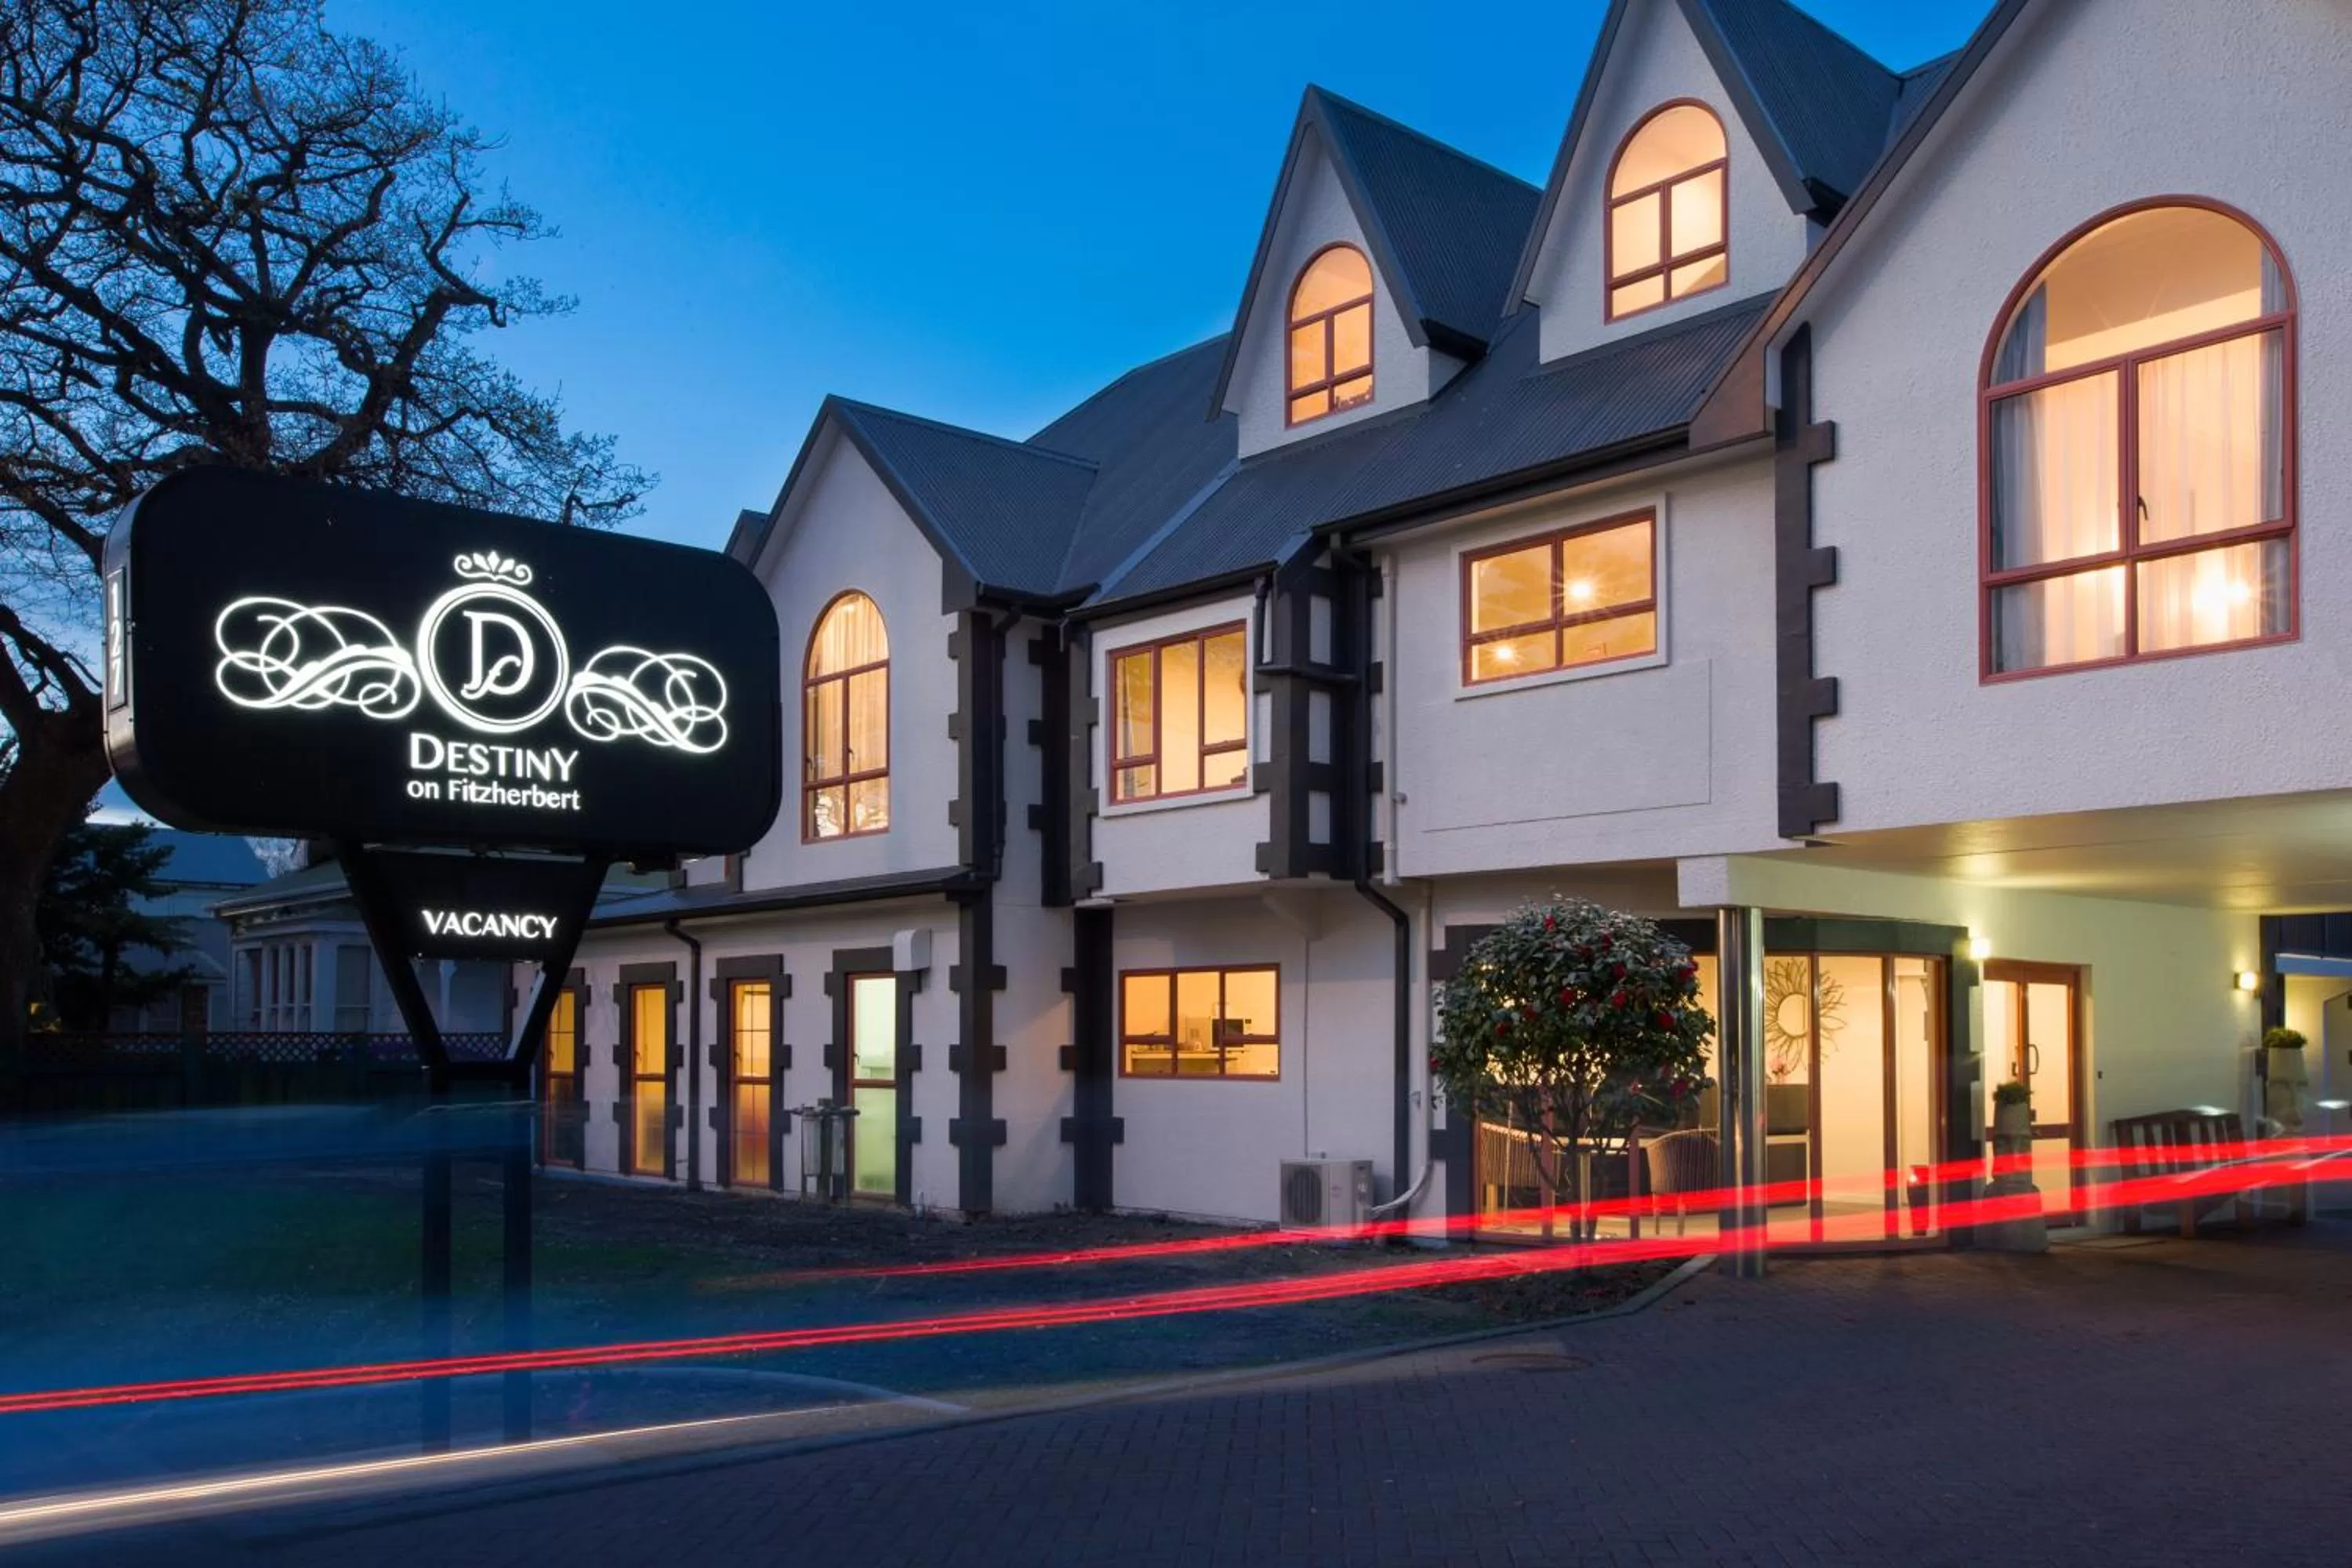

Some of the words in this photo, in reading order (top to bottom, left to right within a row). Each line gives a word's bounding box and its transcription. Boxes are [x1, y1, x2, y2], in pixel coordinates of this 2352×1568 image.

[111, 581, 124, 695] 127
[409, 731, 579, 782] DESTINY
[406, 780, 440, 800] on
[448, 778, 581, 811] Fitzherbert
[421, 909, 557, 939] VACANCY
